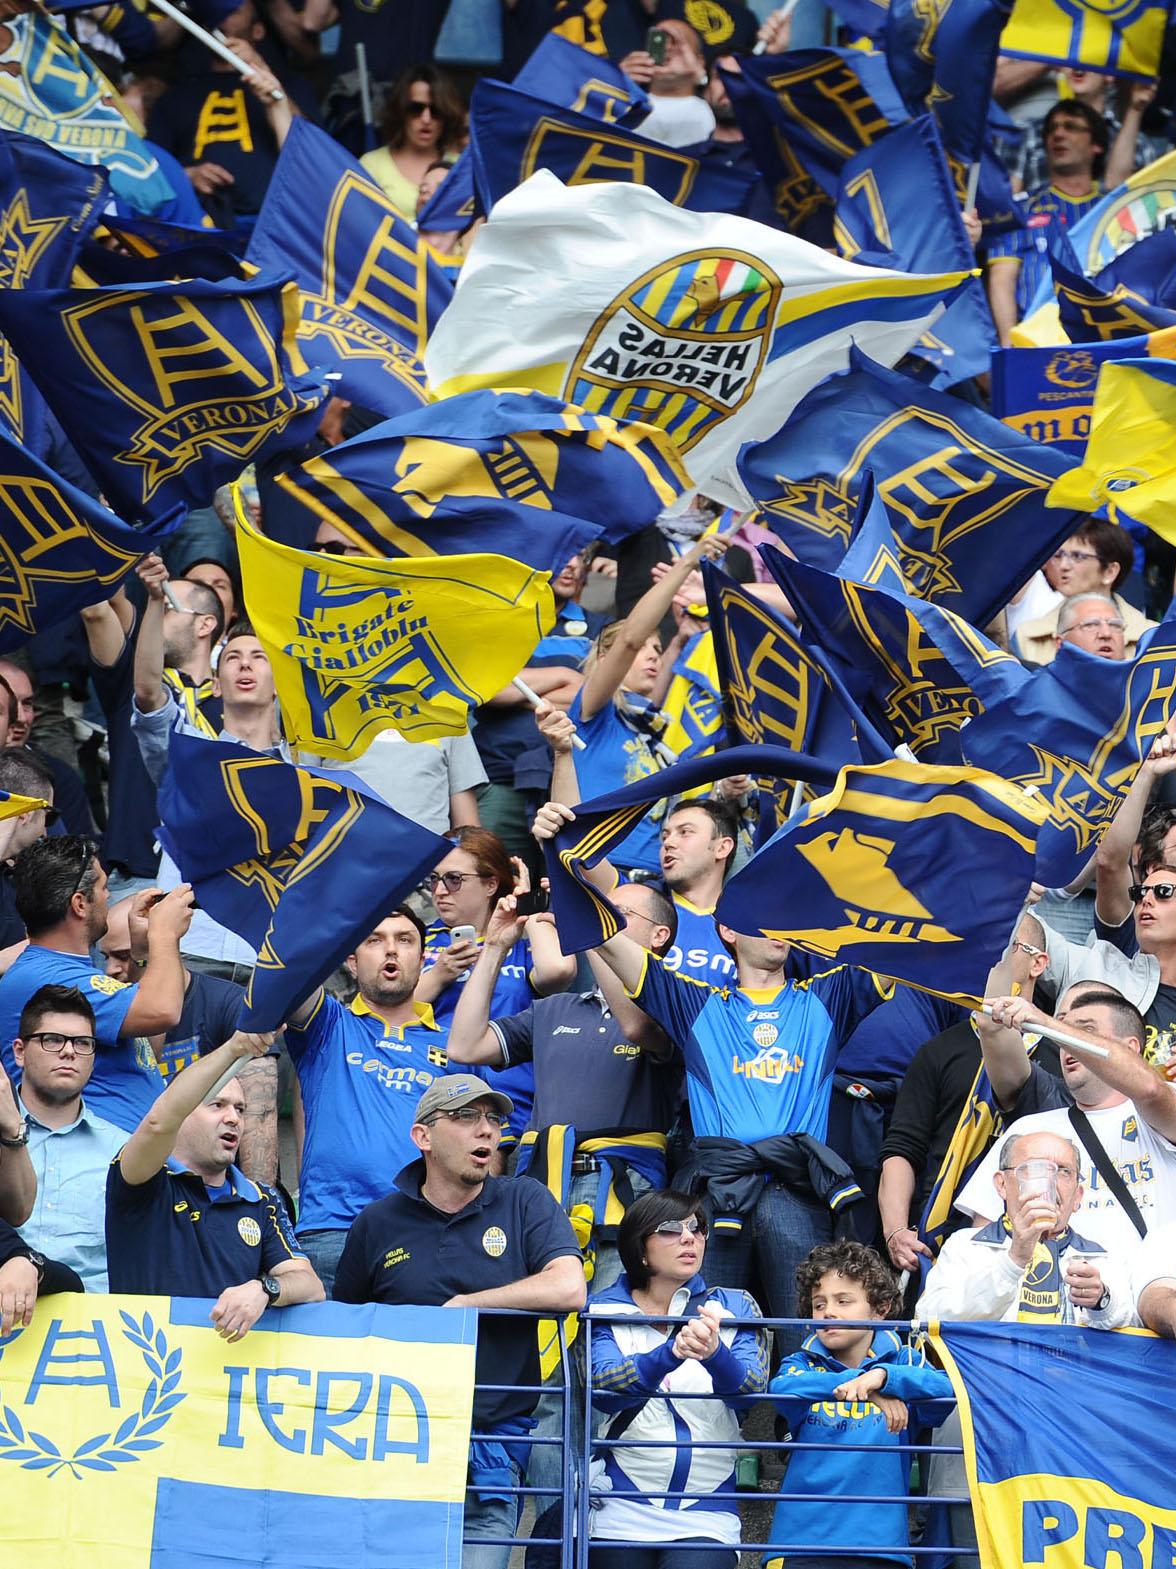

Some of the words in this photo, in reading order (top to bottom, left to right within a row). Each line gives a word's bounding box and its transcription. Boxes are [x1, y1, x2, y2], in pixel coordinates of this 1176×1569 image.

[160, 396, 289, 443] VERONA
[293, 598, 415, 648] Brigate
[1023, 1289, 1053, 1304] VERONA
[218, 1365, 430, 1464] IERA
